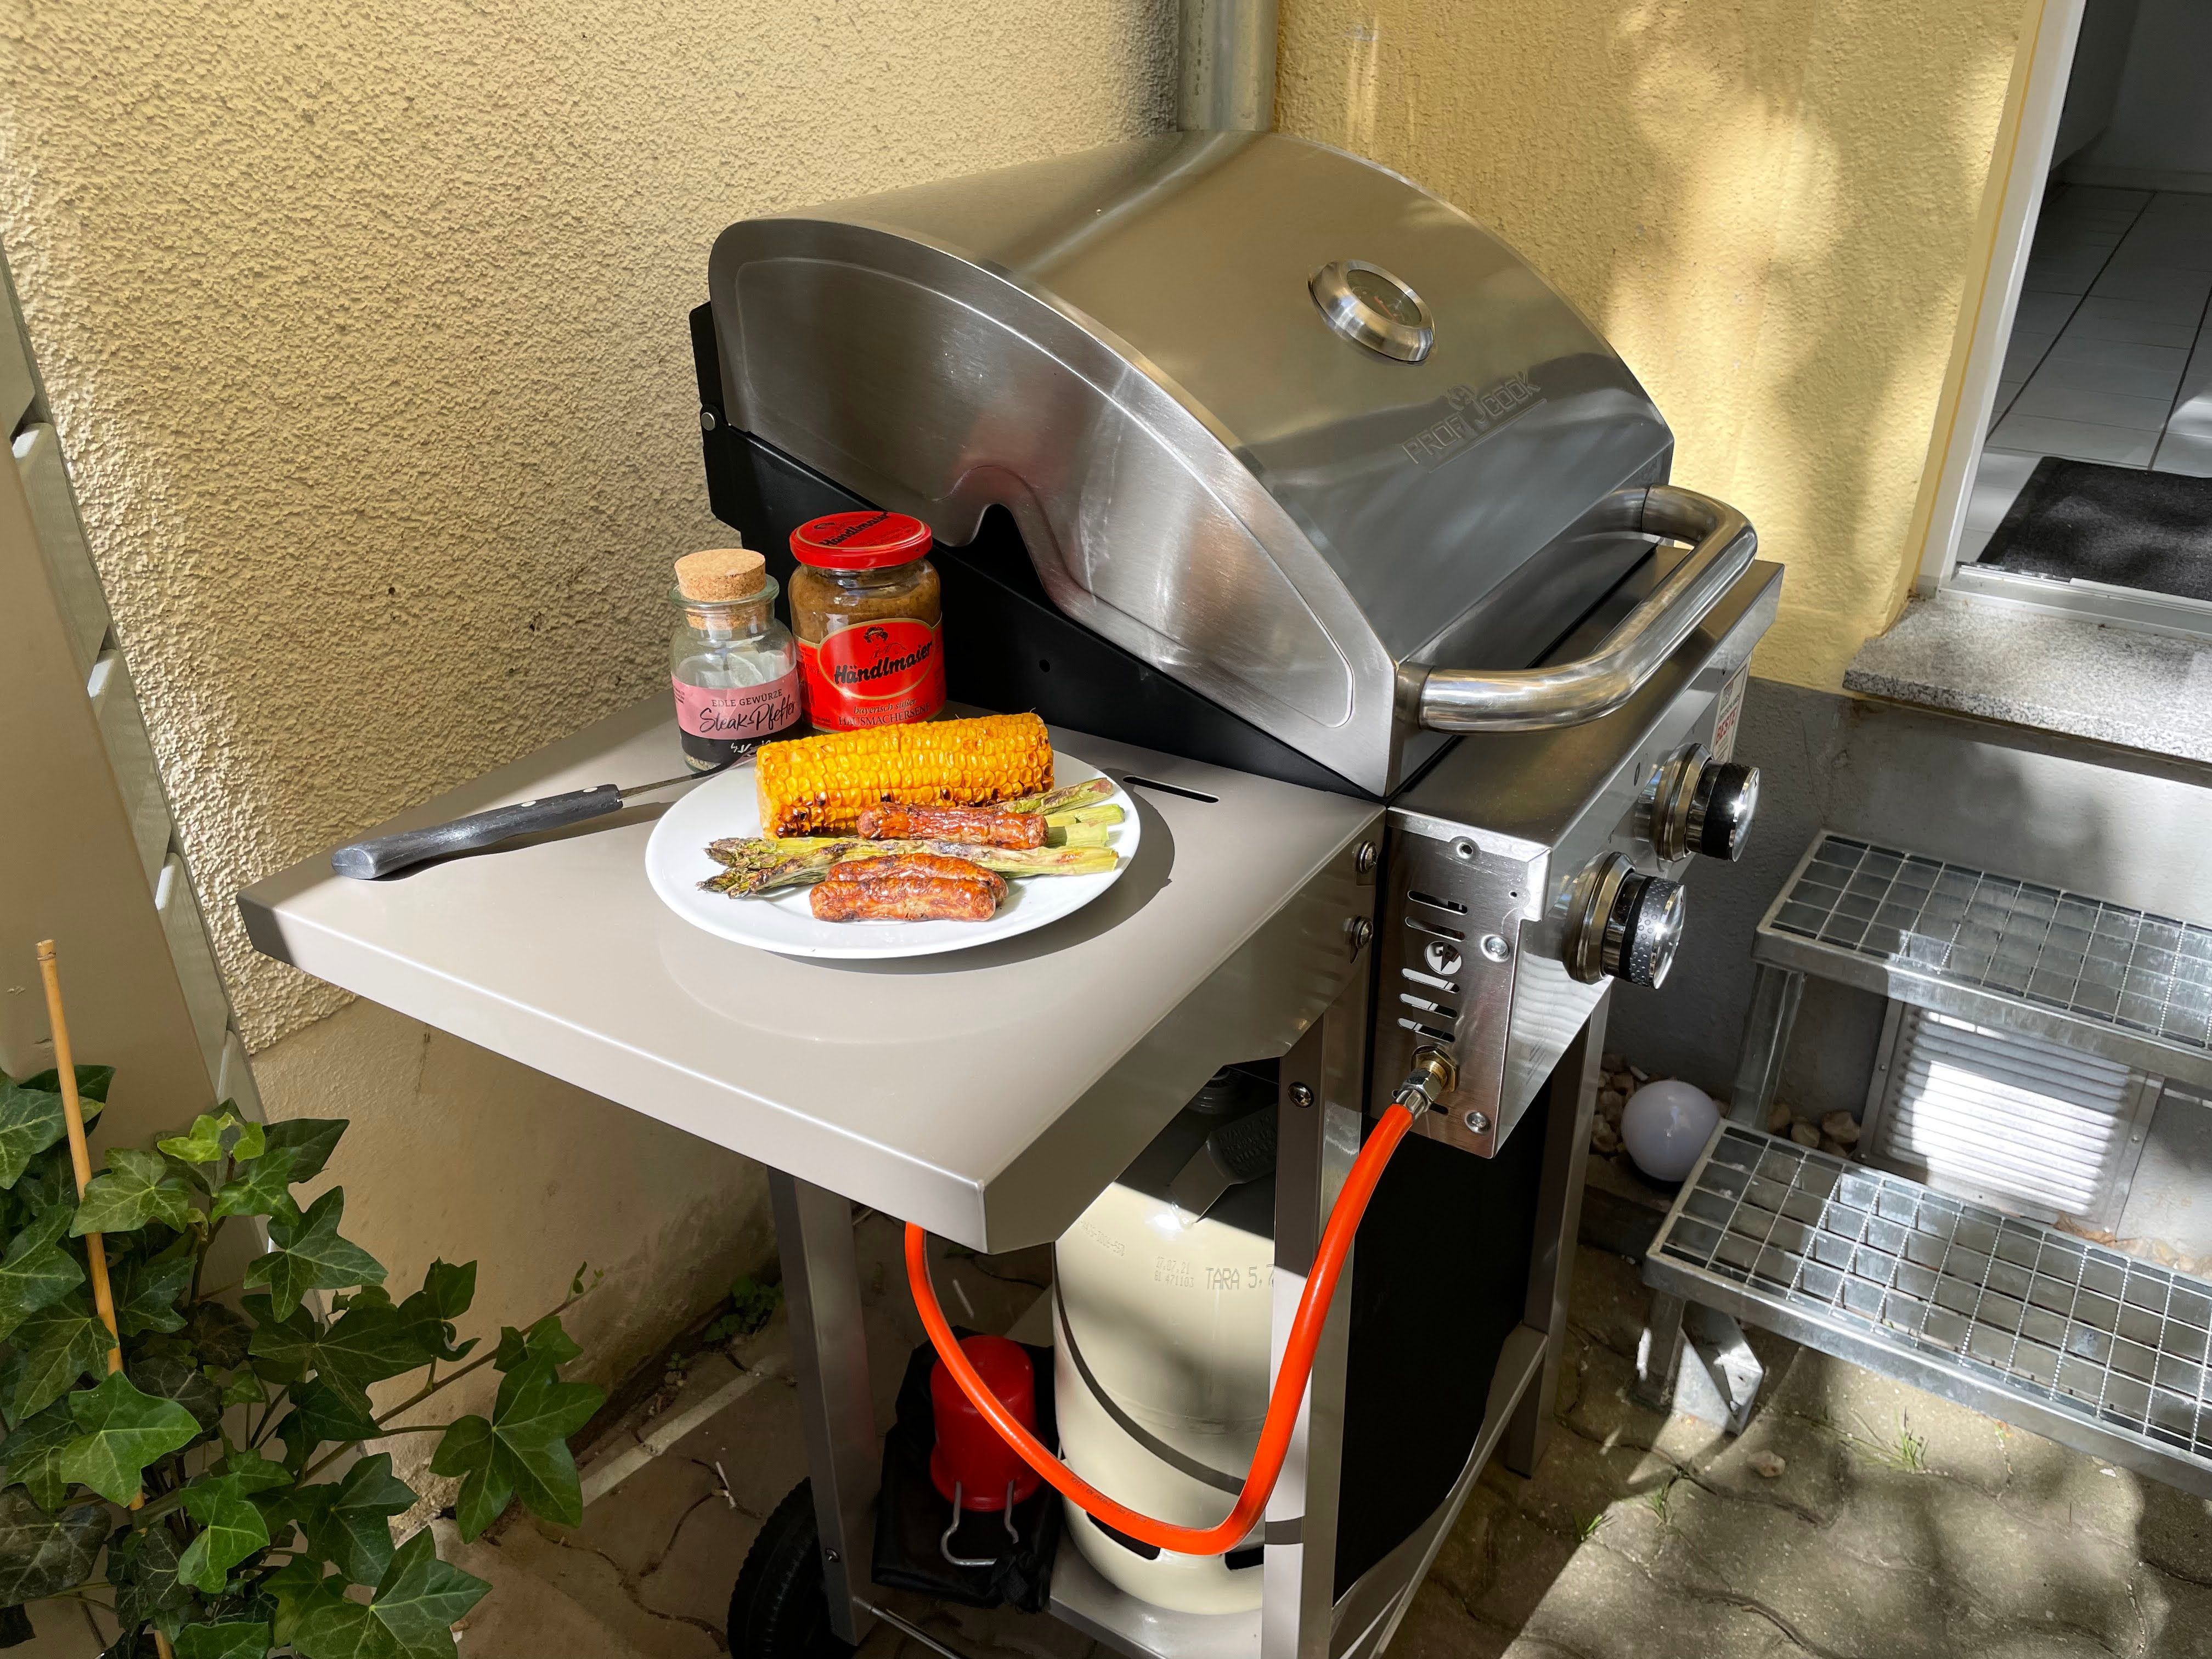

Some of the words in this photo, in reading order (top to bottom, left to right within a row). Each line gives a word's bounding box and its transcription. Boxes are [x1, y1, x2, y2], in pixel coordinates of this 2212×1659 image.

[819, 511, 890, 546] Händlmaier
[833, 640, 933, 685] Händlmaier
[712, 699, 736, 707] EDLE
[738, 689, 783, 706] GEWÜRZE
[853, 702, 893, 718] bayerisch
[1205, 1267, 1240, 1290] TARA
